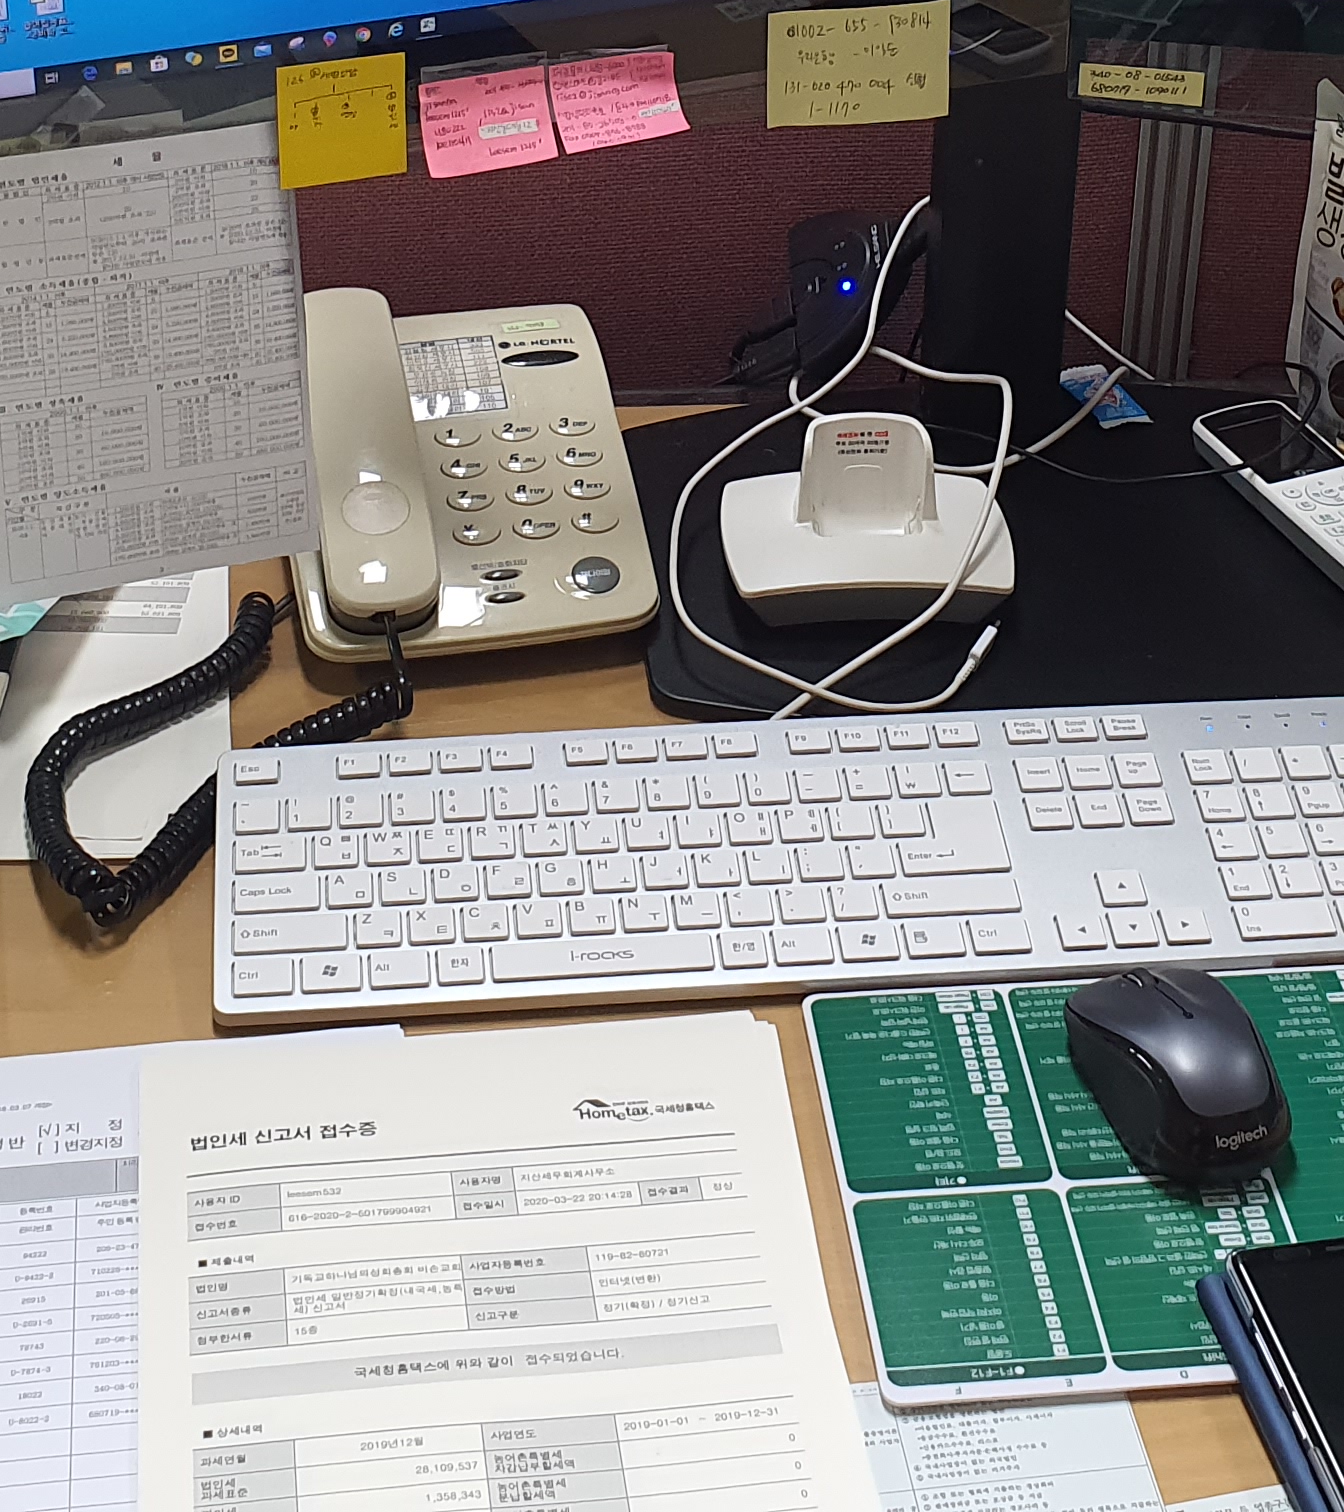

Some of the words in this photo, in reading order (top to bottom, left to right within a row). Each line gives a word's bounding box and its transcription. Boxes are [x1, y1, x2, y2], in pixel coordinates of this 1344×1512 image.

[240, 847, 261, 859] Tab
[907, 850, 933, 862] Enter
[239, 885, 264, 899] Caps
[267, 884, 293, 897] Lock
[238, 970, 260, 982] Ctrl
[190, 1130, 248, 1152] 법인세
[254, 1125, 312, 1145] 신고서
[319, 1120, 378, 1140] 접수증
[1215, 1122, 1270, 1152] logitech
[64, 1135, 123, 1154] 변경지정
[459, 1175, 501, 1187] 사용자명
[520, 1167, 616, 1183] 지산세무회계사무소
[646, 1185, 690, 1198] 접수결과
[712, 1180, 734, 1192] 정상
[194, 1194, 226, 1207] 사용자
[229, 1194, 242, 1205] ID
[462, 1198, 505, 1212] 접수일시
[523, 1194, 586, 1207] 2020-03-22
[588, 1190, 633, 1202] 20:14:28
[194, 1219, 238, 1233] 접수번호
[211, 1253, 255, 1267] 제출내역
[469, 1257, 546, 1272] 사업자등록번호
[667, 1294, 711, 1308] 정기신고
[354, 1360, 451, 1379] 국세청홈택스에
[455, 1356, 484, 1371] 위와
[487, 1354, 514, 1369] 같이
[525, 1347, 626, 1366] 접수되었습니다.
[623, 1416, 690, 1432] 2019-01-01
[714, 1406, 780, 1423] 2019-12-31
[217, 1423, 263, 1439] 상세내역
[360, 1435, 424, 1452] 2019년12월
[415, 1460, 479, 1476] 28,109,537
